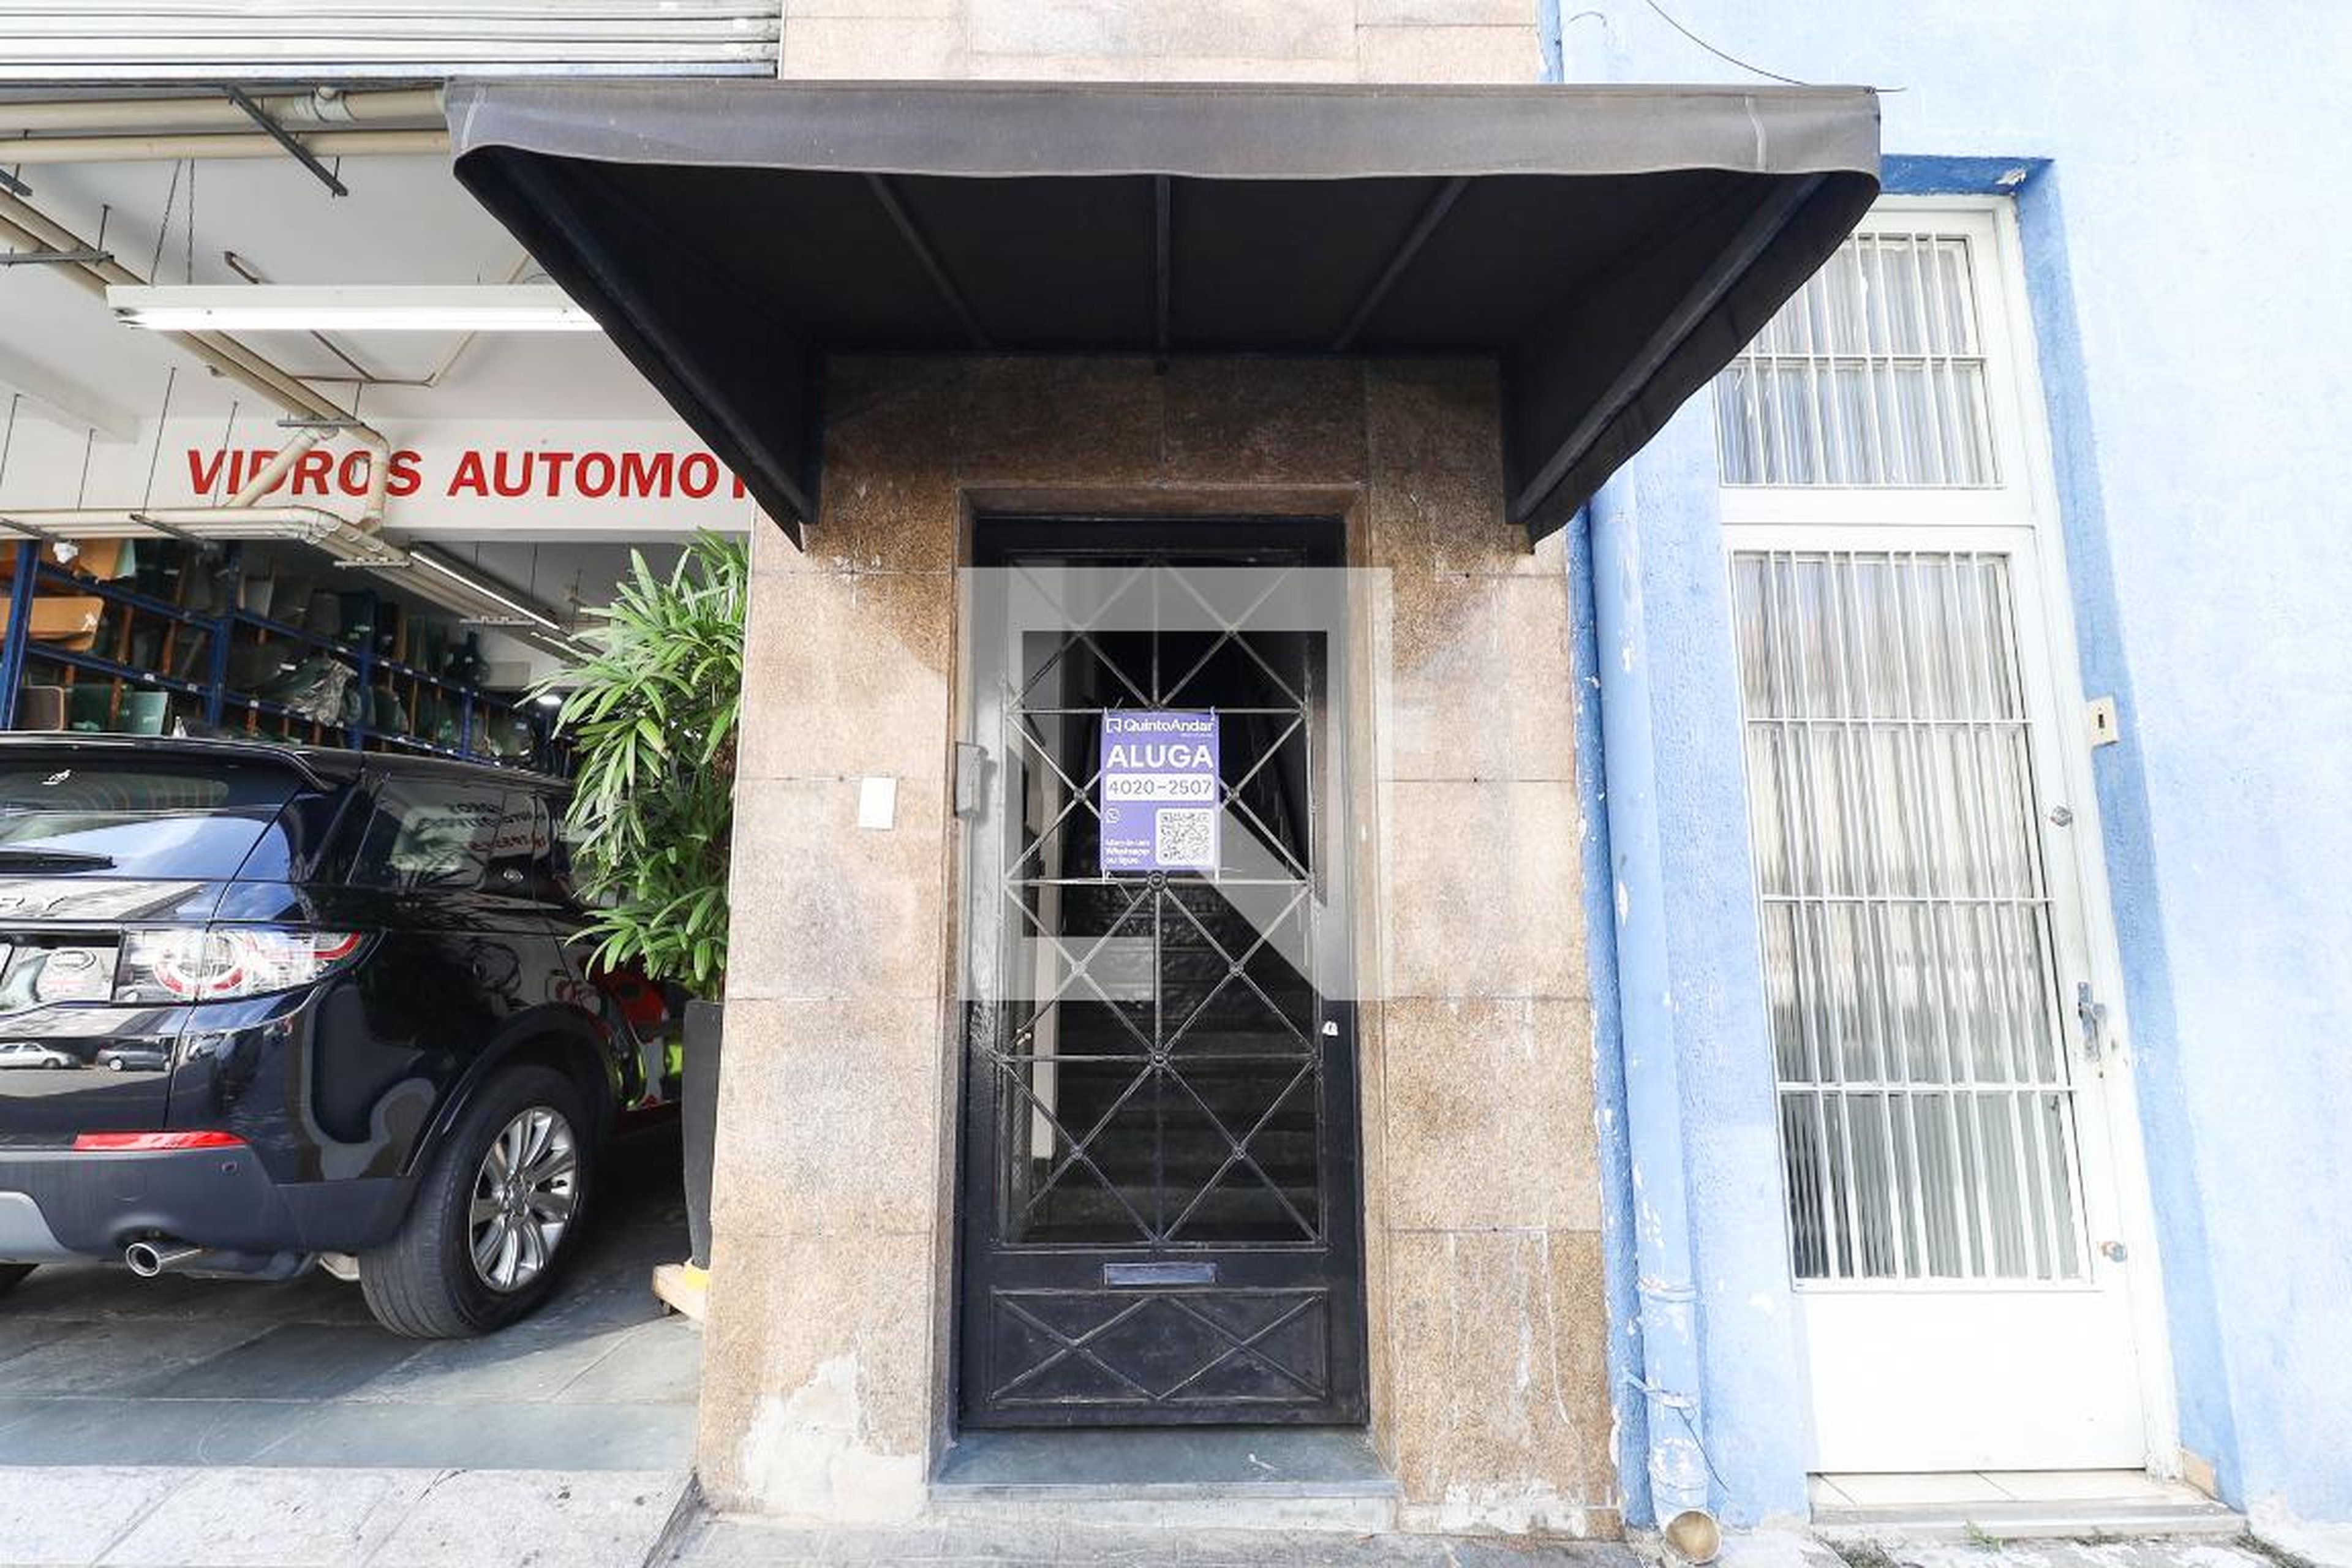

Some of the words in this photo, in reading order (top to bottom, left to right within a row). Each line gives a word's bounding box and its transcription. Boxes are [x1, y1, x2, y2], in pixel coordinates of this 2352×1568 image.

[187, 450, 423, 497] VIDROS
[447, 451, 745, 499] AUTOMO
[1125, 718, 1214, 732] QuintoAndar
[1106, 744, 1214, 768] ALUGA
[1109, 780, 1212, 795] 4020-2507
